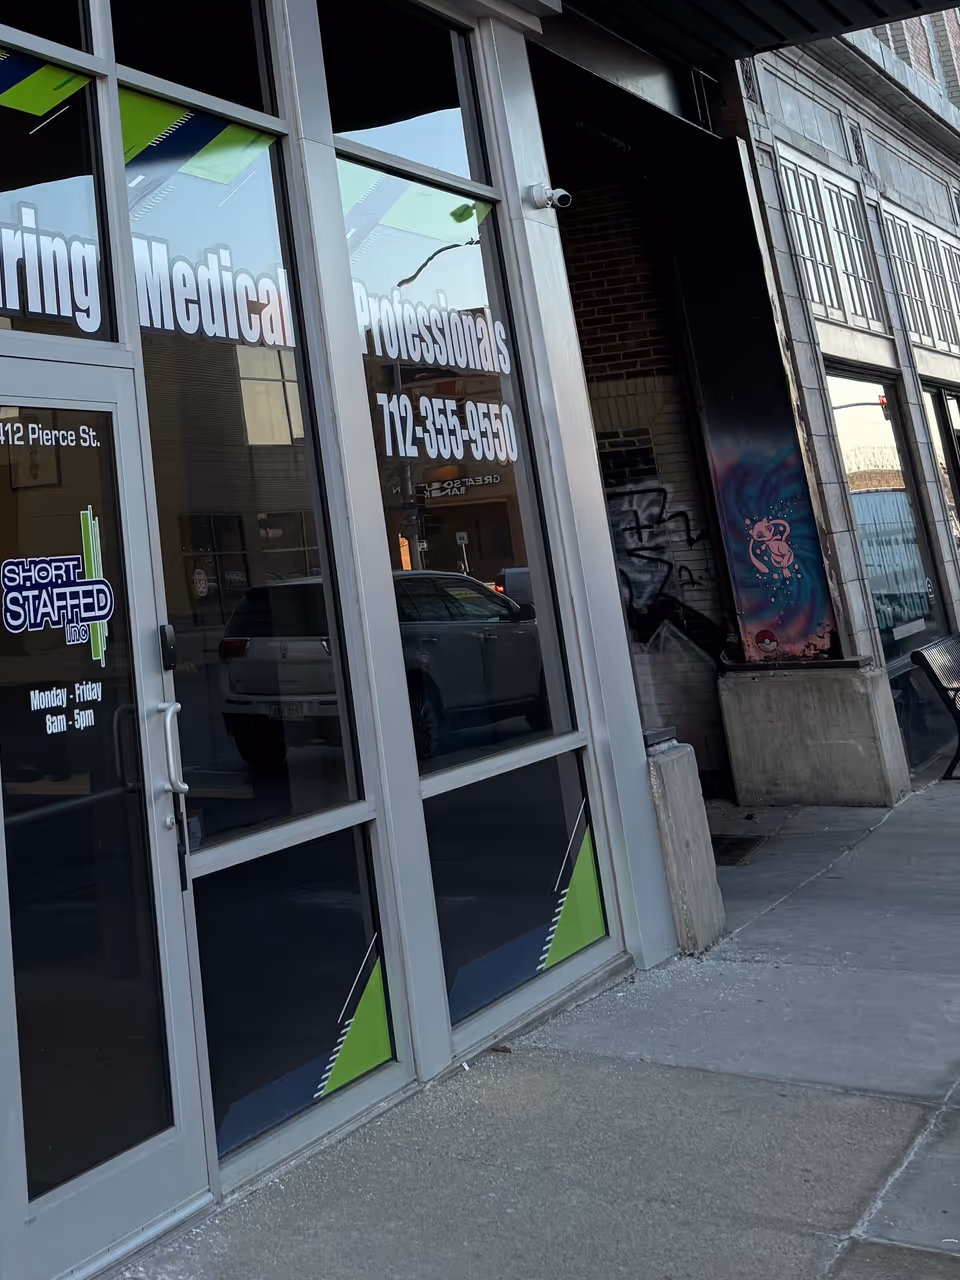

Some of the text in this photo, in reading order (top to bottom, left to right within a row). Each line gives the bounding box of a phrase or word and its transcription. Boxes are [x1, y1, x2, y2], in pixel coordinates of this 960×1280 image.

[131, 237, 296, 349] Medical
[354, 283, 511, 375] Professionals
[28, 423, 76, 447] Pierce
[80, 425, 101, 447] St.
[377, 393, 517, 462] 712-355-9550
[4, 560, 78, 586] SHORT
[6, 581, 111, 627] STAFFED
[30, 687, 67, 712] Monday
[75, 680, 102, 705] Friday
[45, 714, 67, 735] 8am
[74, 707, 95, 730] 5pm
